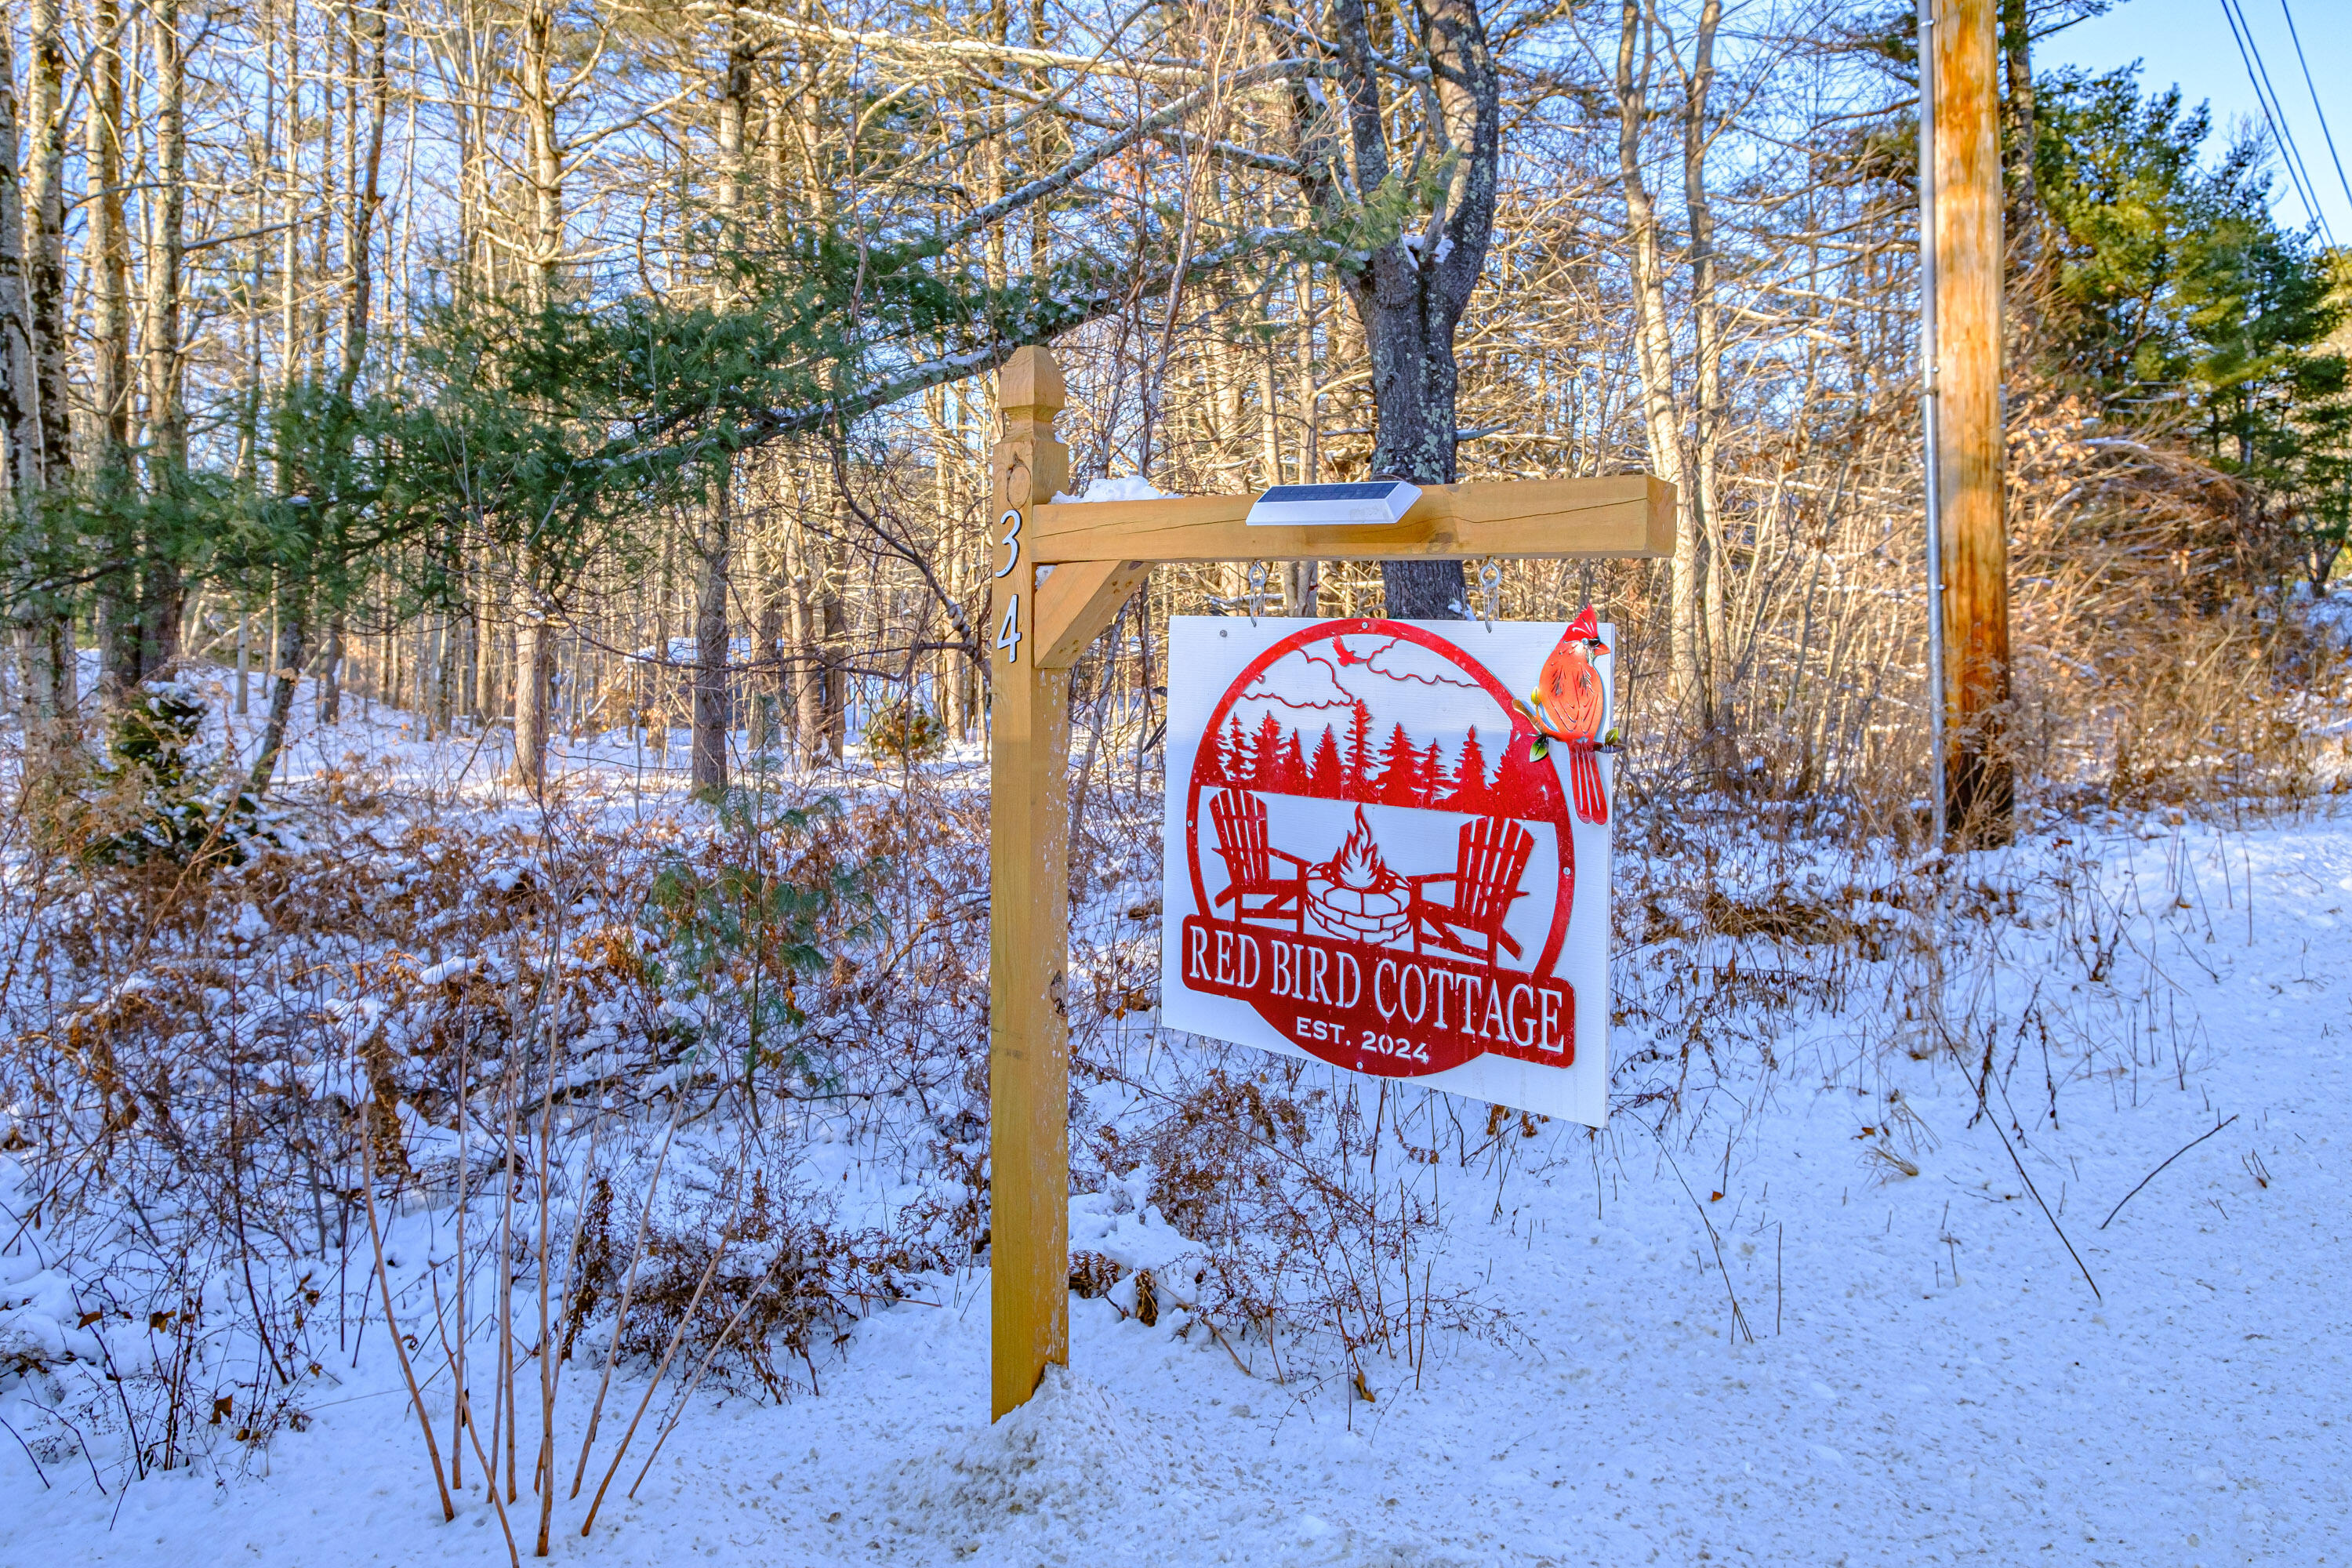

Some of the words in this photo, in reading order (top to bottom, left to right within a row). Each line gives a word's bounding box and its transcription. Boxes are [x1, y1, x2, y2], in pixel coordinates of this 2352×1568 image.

[995, 509, 1022, 663] 34
[1189, 925, 1261, 989] RED
[1270, 939, 1362, 1009] BIRD
[1374, 957, 1565, 1054] COTTAGE
[1296, 1016, 1352, 1047] EST.
[1361, 1030, 1429, 1065] 2024
